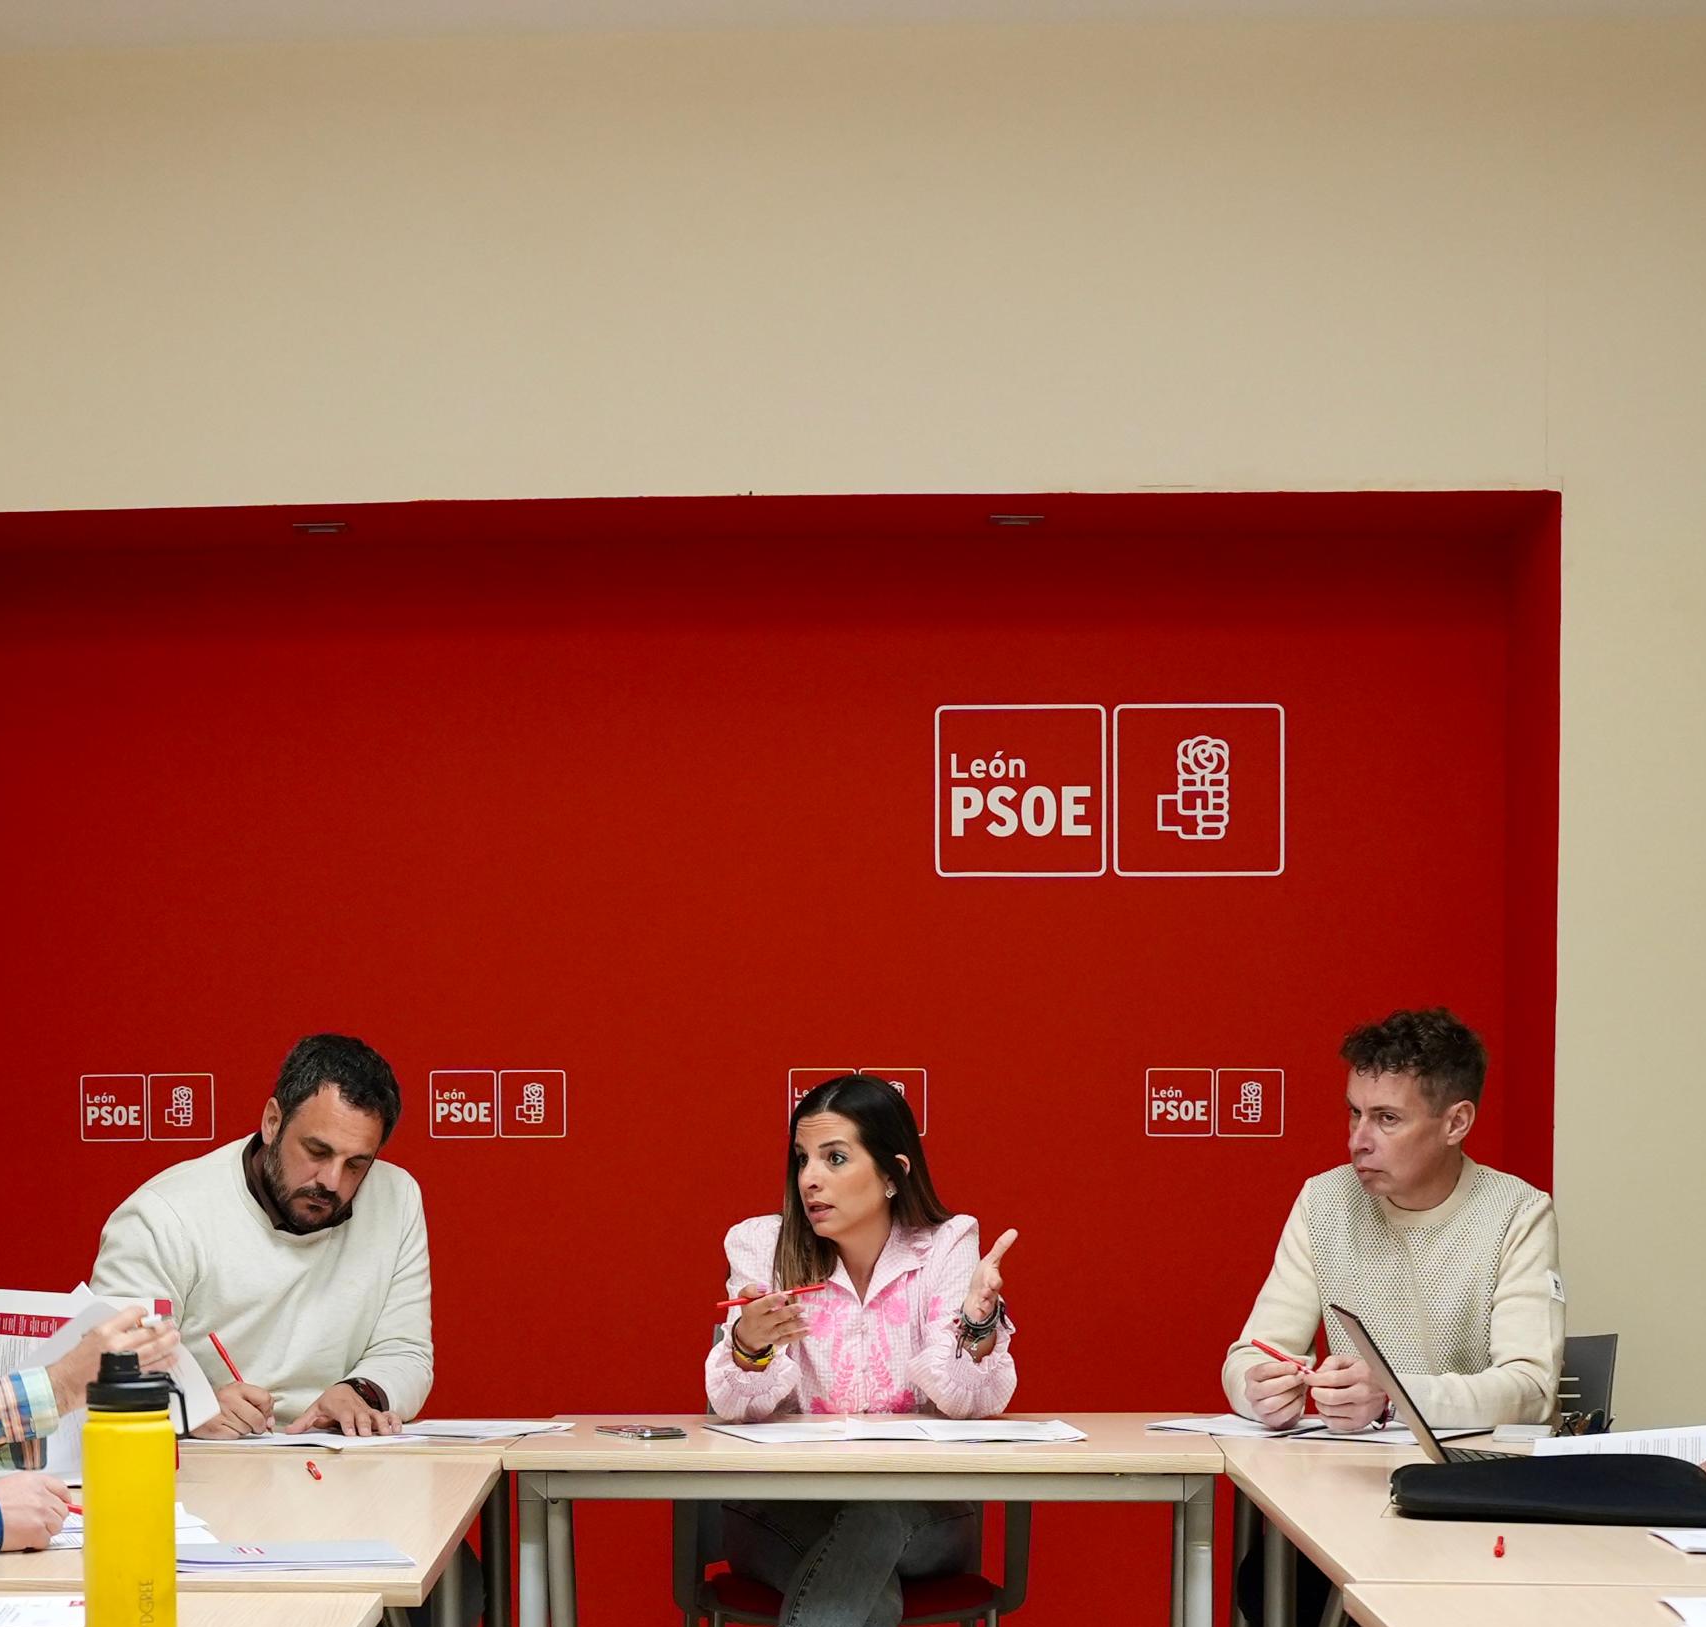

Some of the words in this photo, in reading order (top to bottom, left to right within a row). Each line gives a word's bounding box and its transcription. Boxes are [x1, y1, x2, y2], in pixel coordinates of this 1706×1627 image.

[950, 750, 1027, 779] León
[950, 785, 1092, 838] PSOE
[86, 1091, 116, 1104] León
[435, 1088, 466, 1100] León
[1151, 1086, 1183, 1098] León
[86, 1105, 142, 1126] PSOE
[435, 1102, 492, 1123] PSOE
[1151, 1100, 1208, 1121] PSOE
